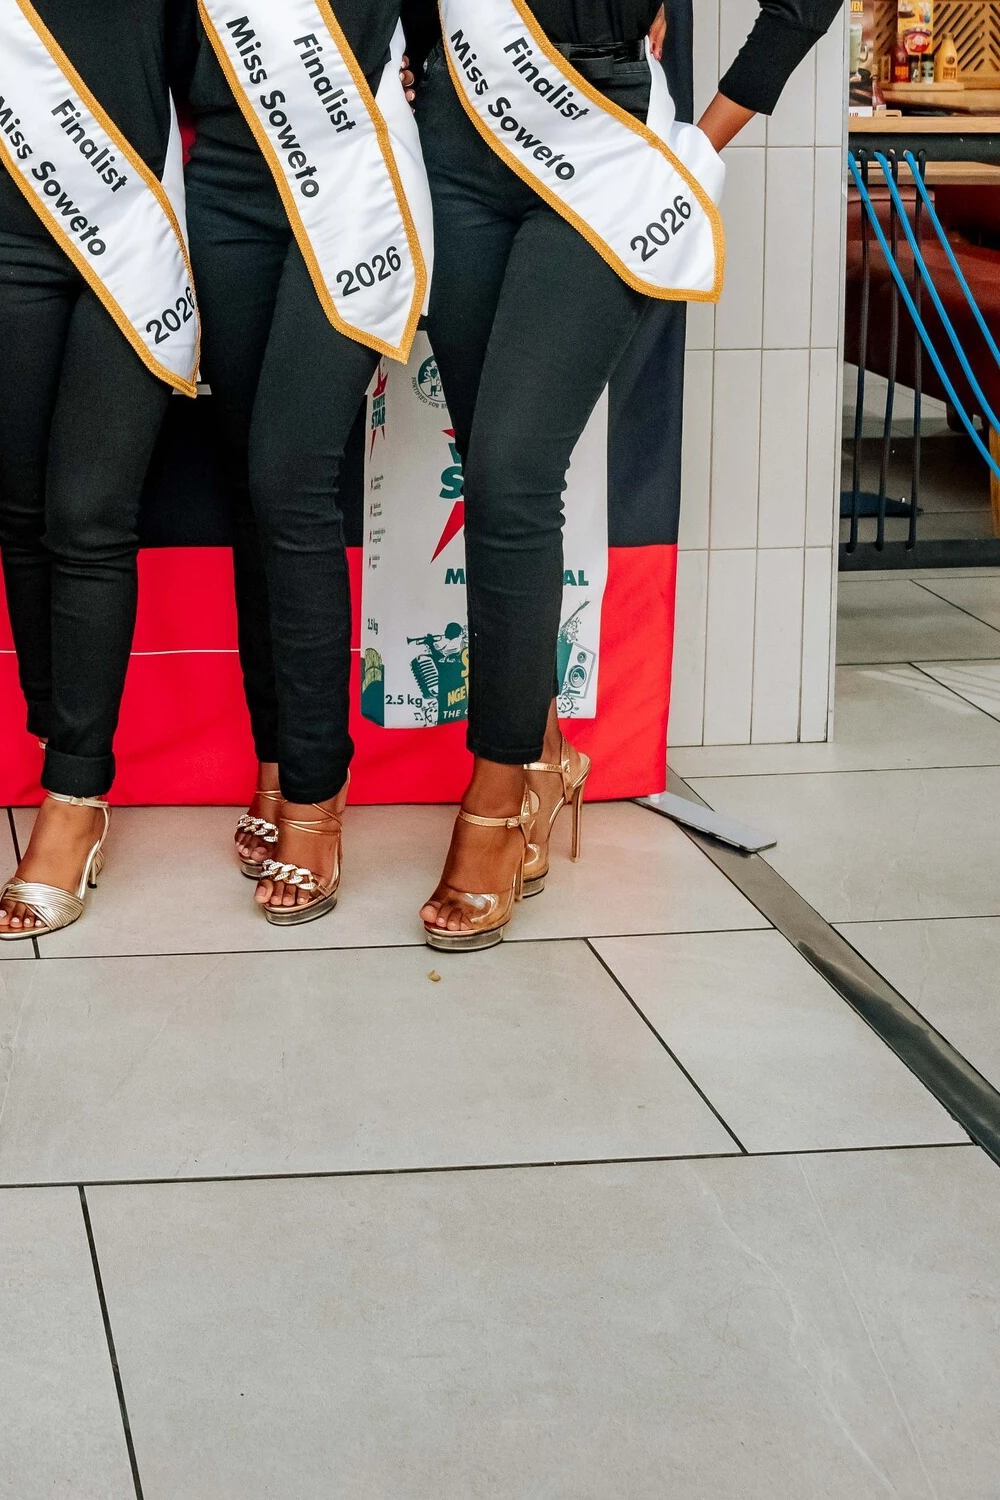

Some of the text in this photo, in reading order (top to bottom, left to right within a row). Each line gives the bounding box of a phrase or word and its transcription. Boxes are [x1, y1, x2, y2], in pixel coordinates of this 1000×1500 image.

[226, 15, 320, 199] Miss Soweto
[293, 33, 357, 134] Finalist
[450, 29, 576, 181] Miss Soweto
[503, 36, 591, 123] Finalist
[51, 98, 128, 193] Finalist
[31, 160, 107, 257] Soweto
[629, 194, 692, 262] 2026
[336, 245, 402, 297] 2026
[385, 694, 423, 708] 2.5 kg
[442, 709, 461, 719] THE
